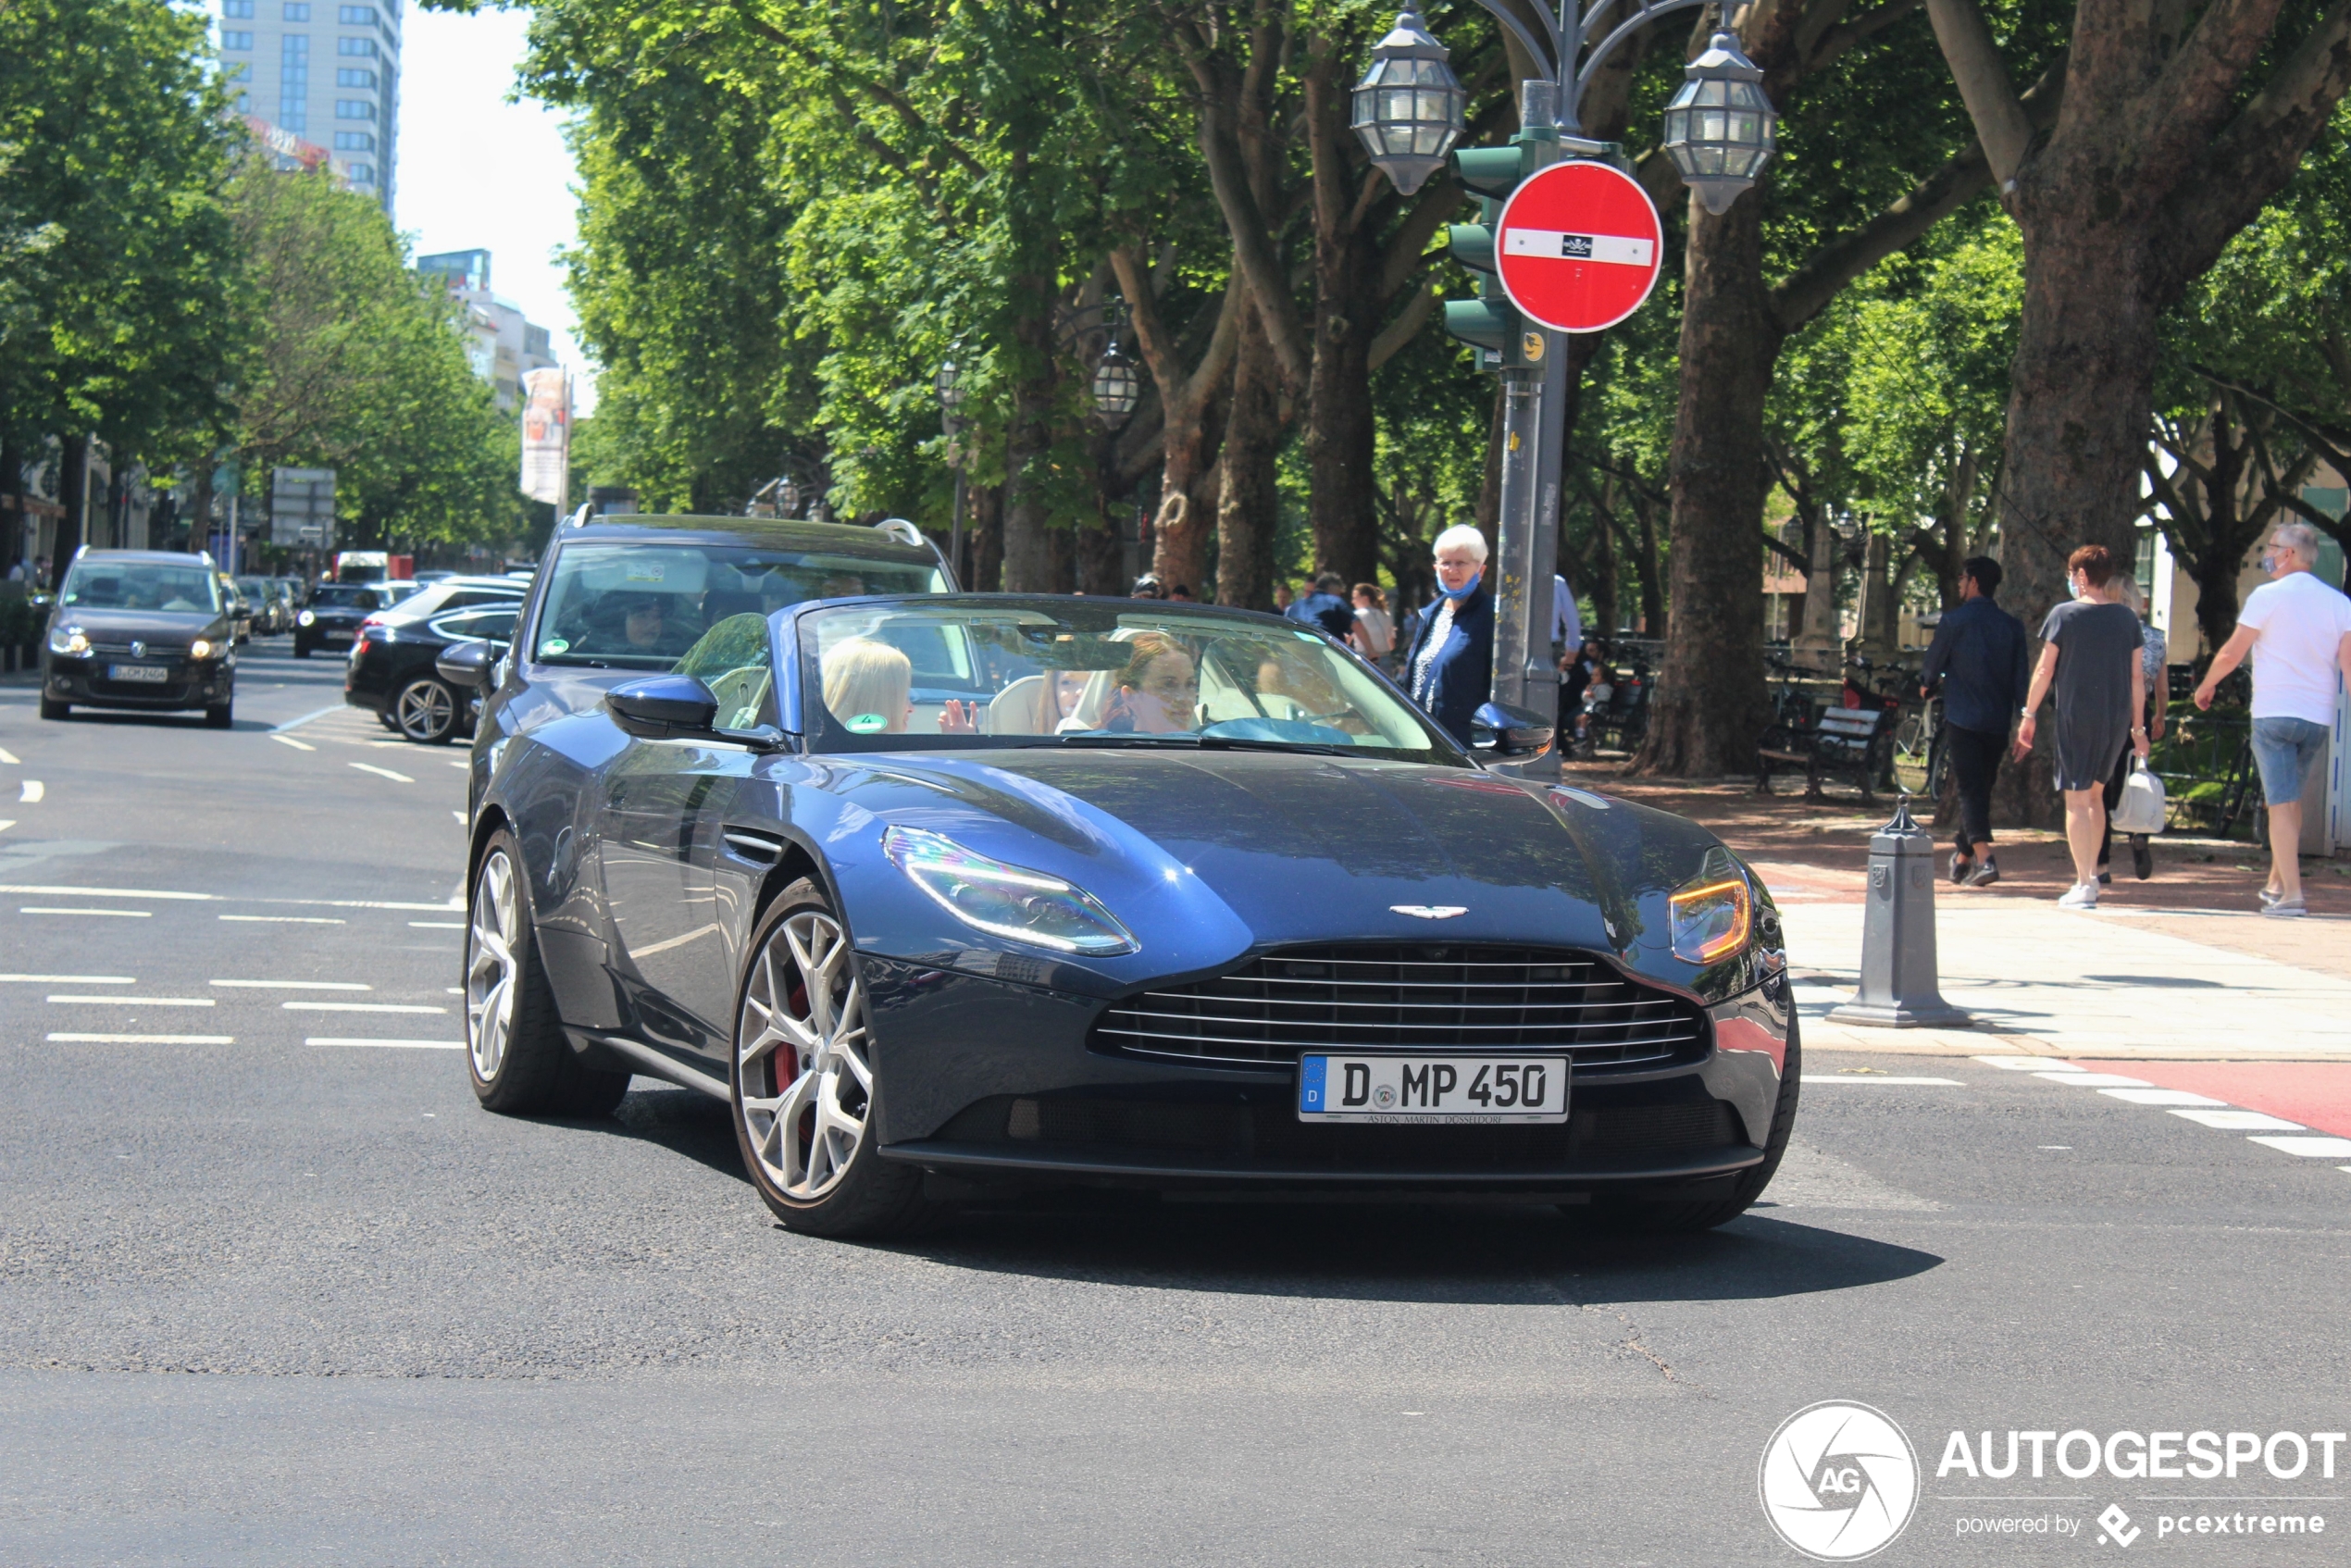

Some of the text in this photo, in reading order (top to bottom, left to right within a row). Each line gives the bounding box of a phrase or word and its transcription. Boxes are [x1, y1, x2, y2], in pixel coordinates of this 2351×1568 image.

[862, 716, 872, 724] 4
[1342, 1063, 1546, 1107] D MP 450
[1308, 1089, 1318, 1102] D
[1367, 1115, 1399, 1124] ASTON
[1404, 1115, 1440, 1124] MARTIN
